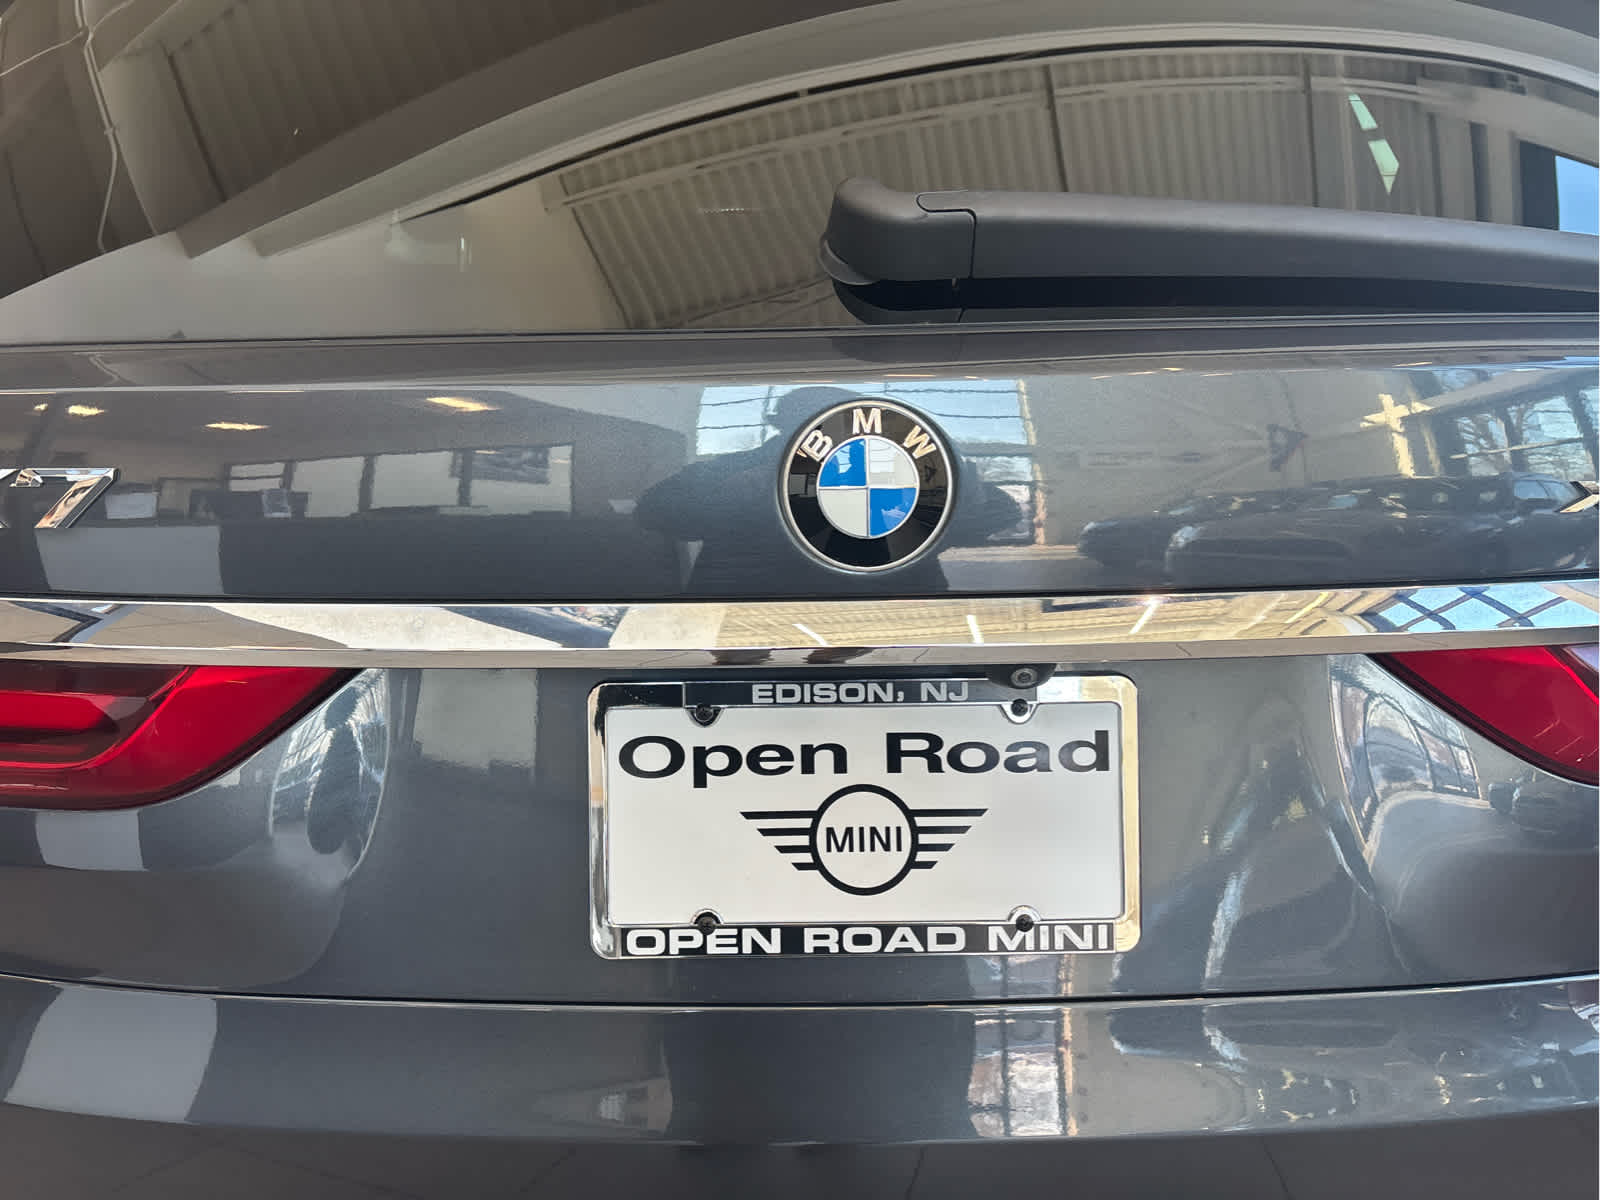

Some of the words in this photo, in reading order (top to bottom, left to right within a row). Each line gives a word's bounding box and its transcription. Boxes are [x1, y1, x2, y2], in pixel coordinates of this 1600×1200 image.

[800, 408, 937, 462] BMW
[0, 468, 119, 528] 7
[752, 682, 905, 705] EDISON,
[920, 681, 969, 701] NJ
[618, 735, 848, 789] Open
[886, 730, 1110, 774] Road
[825, 825, 904, 853] MINI
[625, 928, 782, 955] OPEN
[803, 927, 966, 953] ROAD
[987, 925, 1109, 952] MINI
